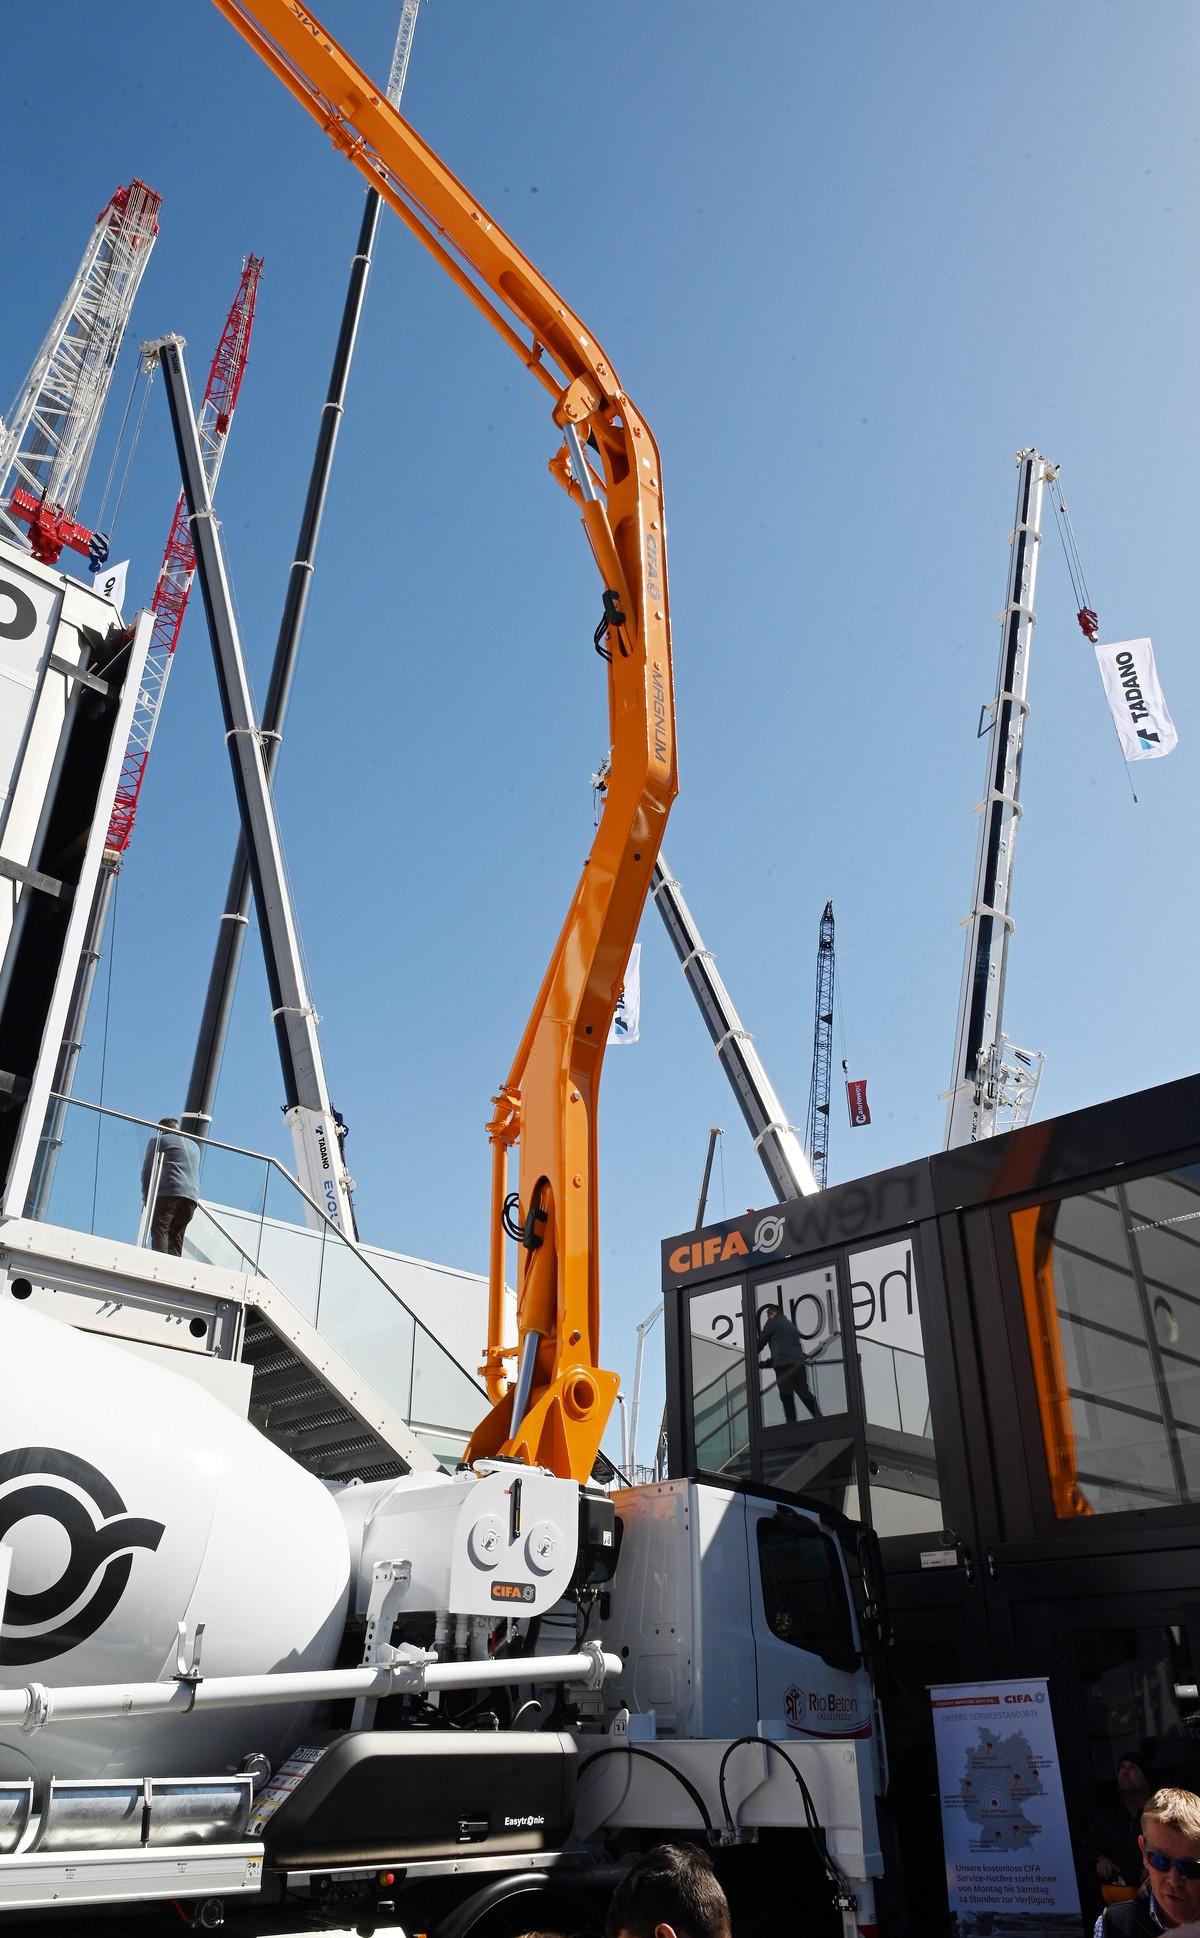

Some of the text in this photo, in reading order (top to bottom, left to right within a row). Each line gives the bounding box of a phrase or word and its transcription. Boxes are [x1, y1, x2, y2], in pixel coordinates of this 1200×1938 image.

[646, 533, 659, 578] CIFA
[1115, 651, 1149, 724] TADANO
[653, 669, 667, 763] MAGNUM
[318, 1136, 330, 1170] TADANO
[669, 1230, 750, 1274] CIFA
[492, 1584, 522, 1599] CIFA
[1004, 1694, 1034, 1704] CIFA
[955, 1864, 1041, 1873] Unsere kostenlose CIFA
[957, 1874, 1057, 1883] Service-Hotline steht Ihnen
[973, 1885, 1003, 1894] Montag
[1004, 1885, 1015, 1893] bis
[1016, 1886, 1049, 1895] Samstag
